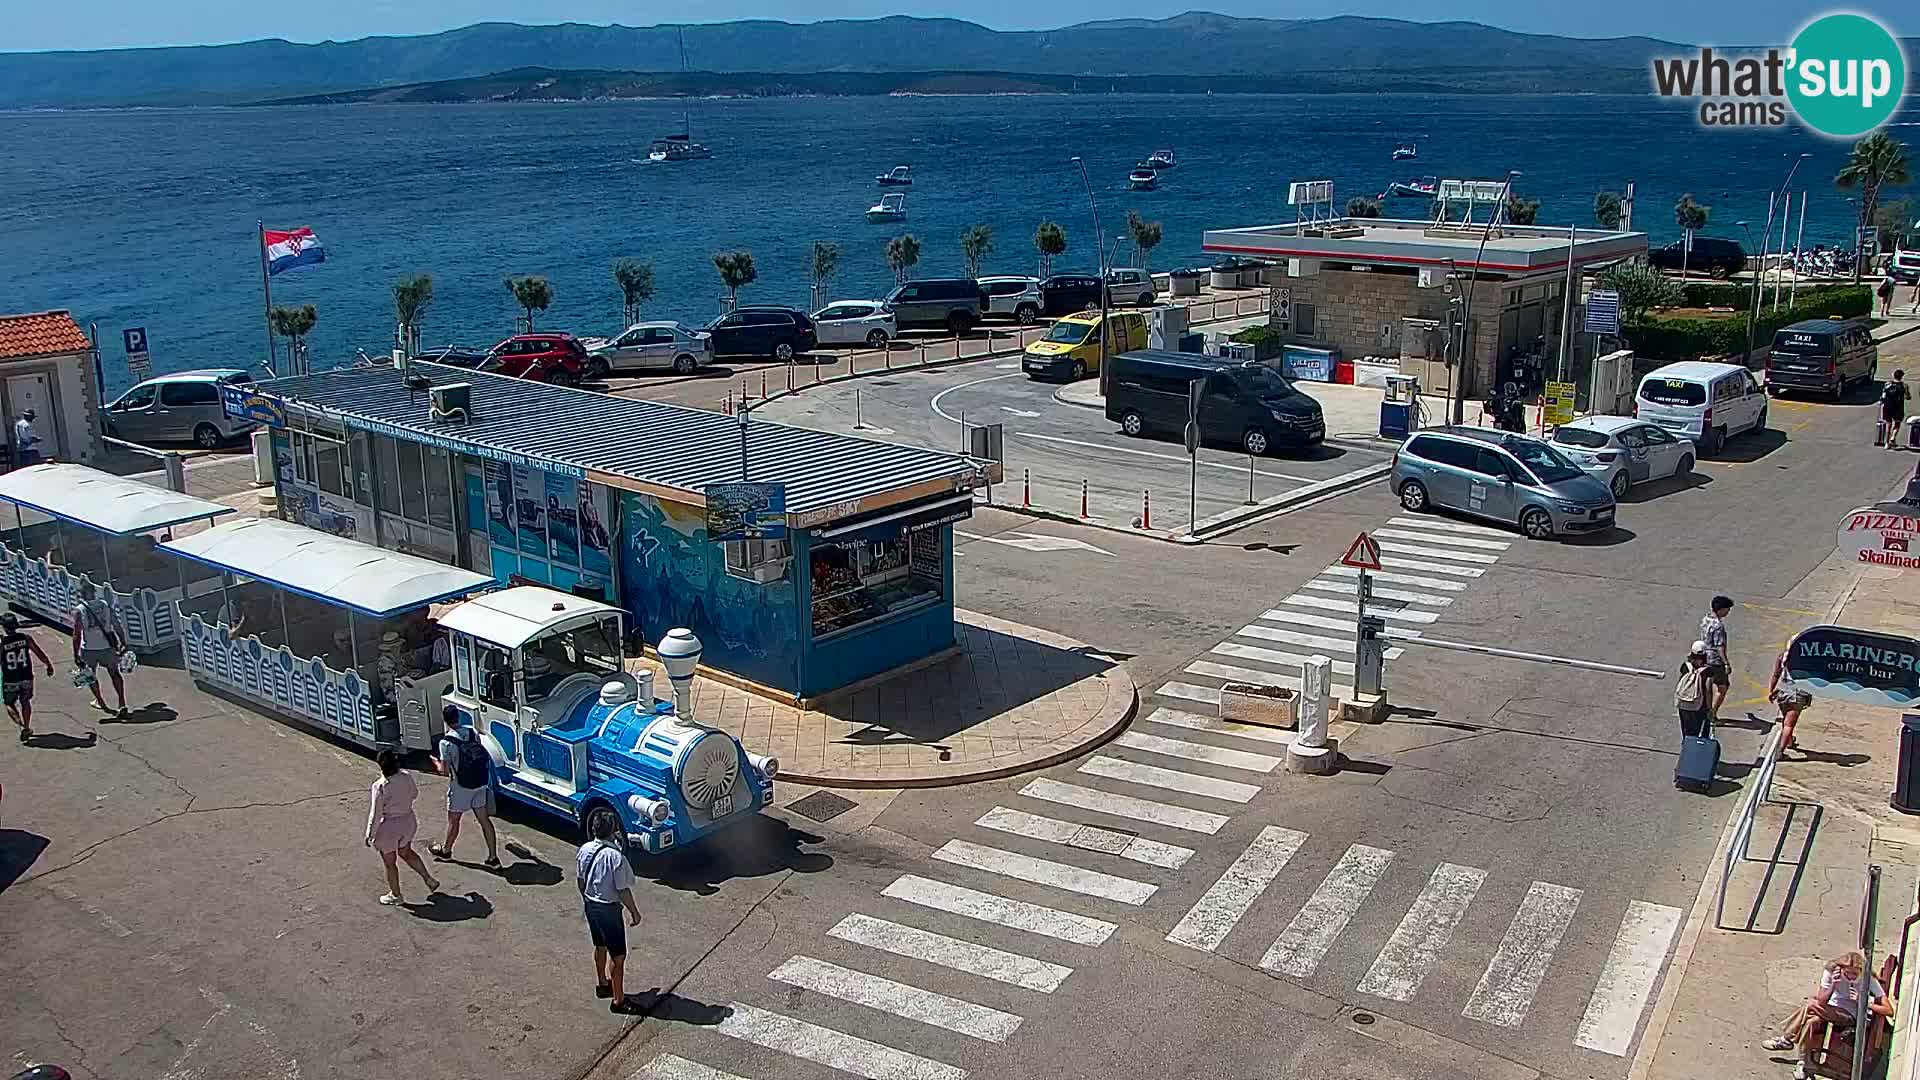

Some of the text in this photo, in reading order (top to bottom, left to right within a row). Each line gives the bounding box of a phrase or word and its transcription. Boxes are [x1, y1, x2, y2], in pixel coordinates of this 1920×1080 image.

[1665, 380, 1684, 388] TAXI
[395, 428, 436, 444] AUTOBUSKA
[436, 437, 467, 452] POSTAJA
[477, 447, 492, 458] BUS
[493, 449, 525, 465] STATION
[528, 457, 553, 471] TICKET
[554, 463, 581, 477] OFFICE
[1881, 530, 1912, 540] GRILL
[1858, 549, 1920, 569] Skalinad
[7, 648, 27, 669] 94
[1869, 665, 1896, 680] bar
